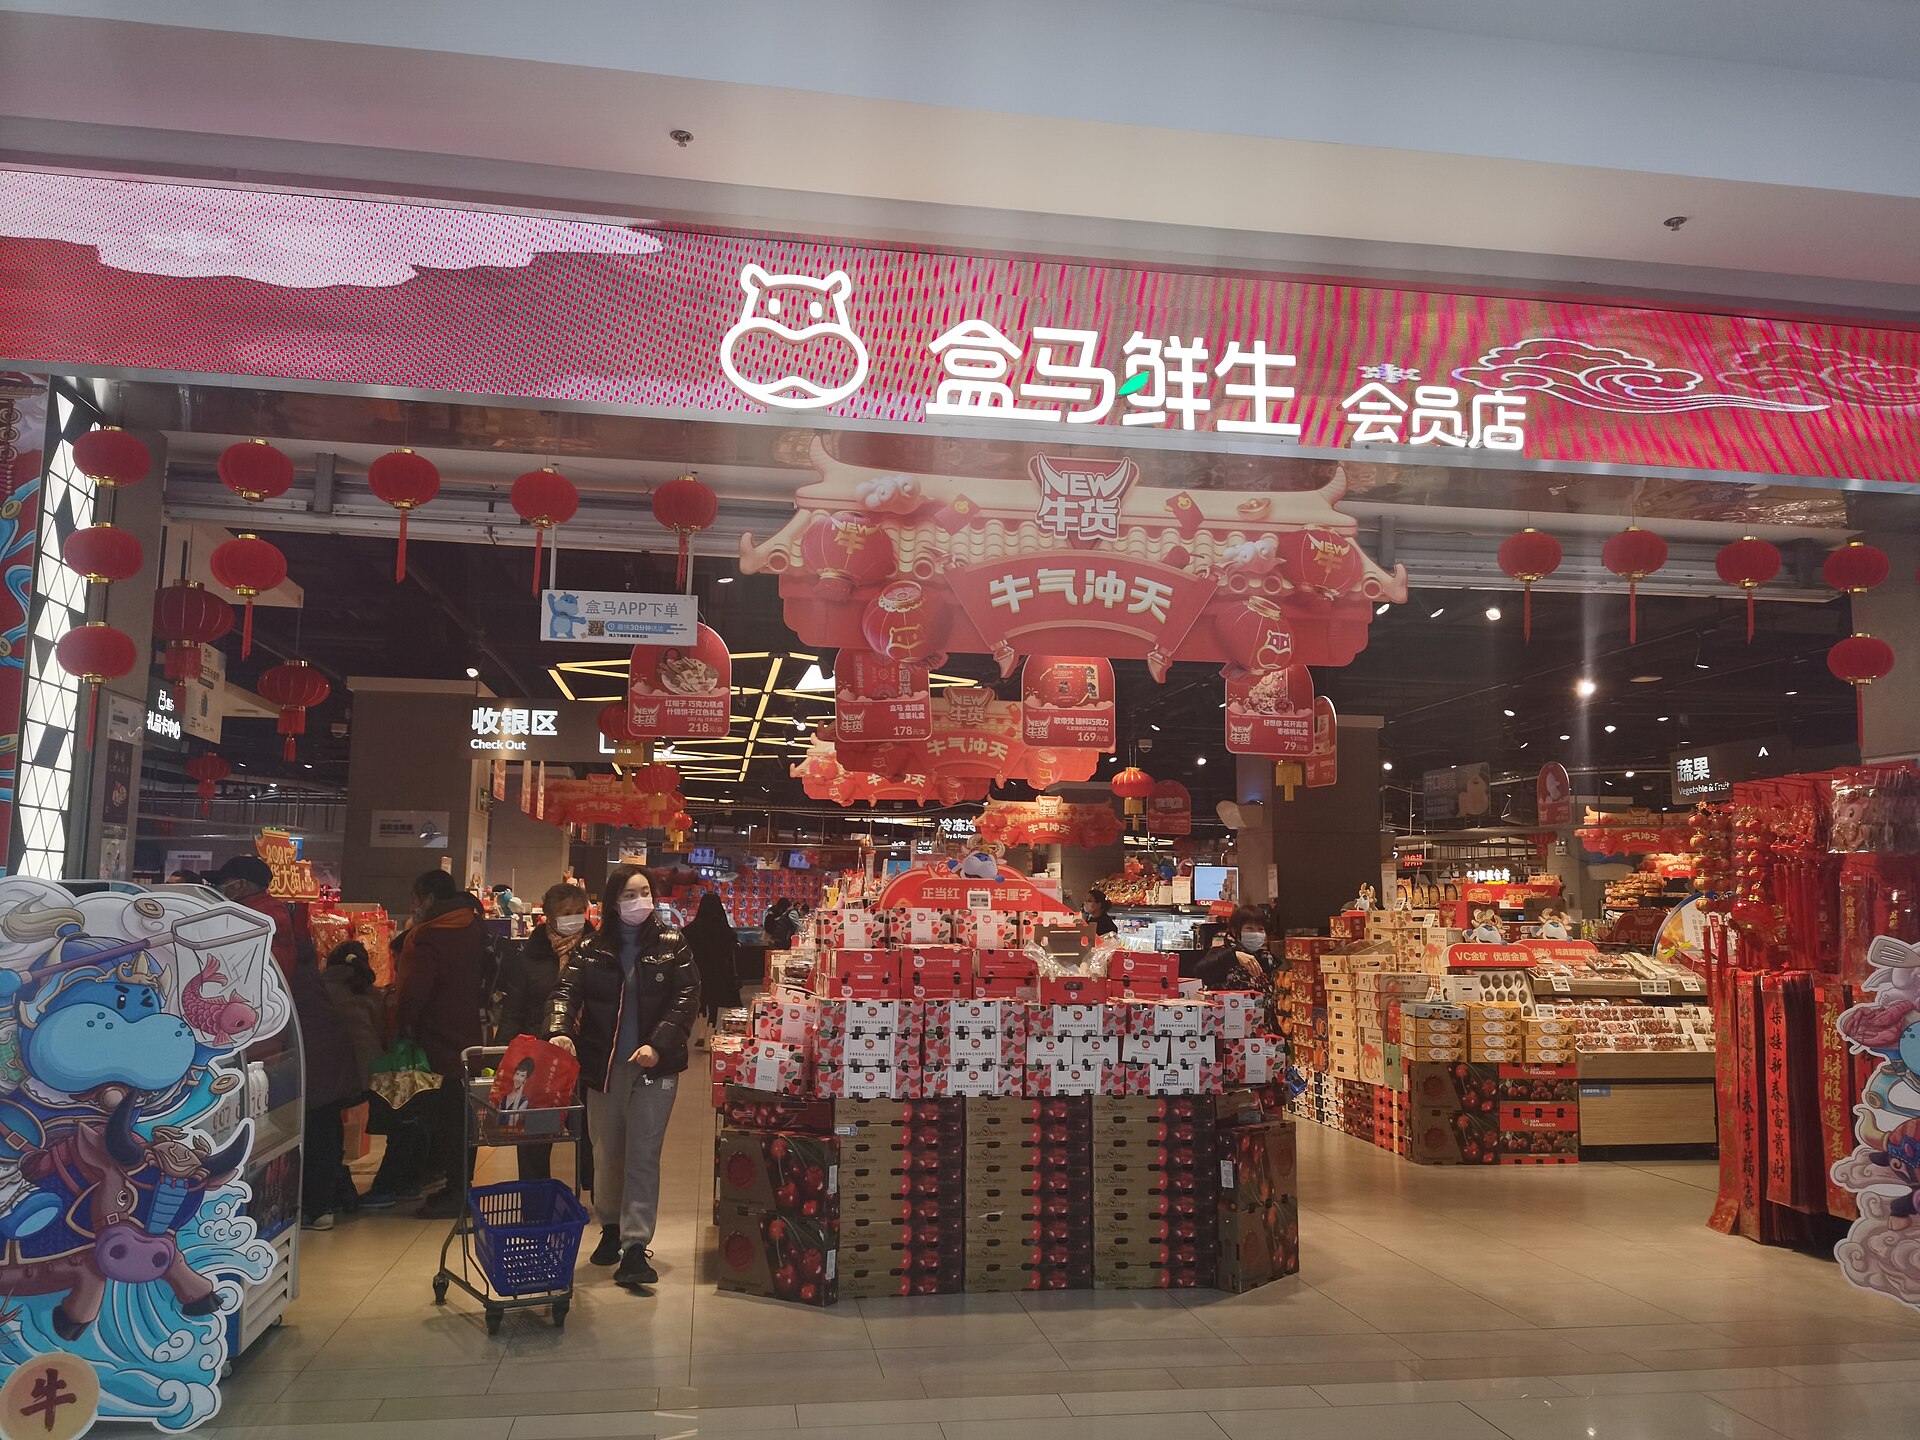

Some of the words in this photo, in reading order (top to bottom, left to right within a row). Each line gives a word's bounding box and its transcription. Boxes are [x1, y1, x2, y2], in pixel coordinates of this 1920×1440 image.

[926, 319, 1301, 435] 盒马鲜生
[1341, 382, 1527, 451] 会员店
[1038, 462, 1130, 495] NEW
[1040, 498, 1121, 539] 牛货
[585, 599, 680, 618] 盒马APP下单
[990, 568, 1175, 624] 牛气冲天
[146, 709, 181, 740] 礼品卡中心
[471, 707, 559, 736] 收银区
[470, 738, 504, 751] Check
[505, 740, 527, 751] Out
[926, 736, 1008, 762] 牛气冲天
[1676, 756, 1711, 783] 蔬果
[576, 801, 623, 814] 牛气冲天
[1027, 822, 1071, 835] 牛气冲天
[1622, 831, 1660, 843] 牛气冲天
[922, 887, 960, 900] 正当红
[1455, 952, 1489, 962] VC金矿
[1493, 952, 1529, 962] 优质金果
[19, 1367, 78, 1432] 牛
